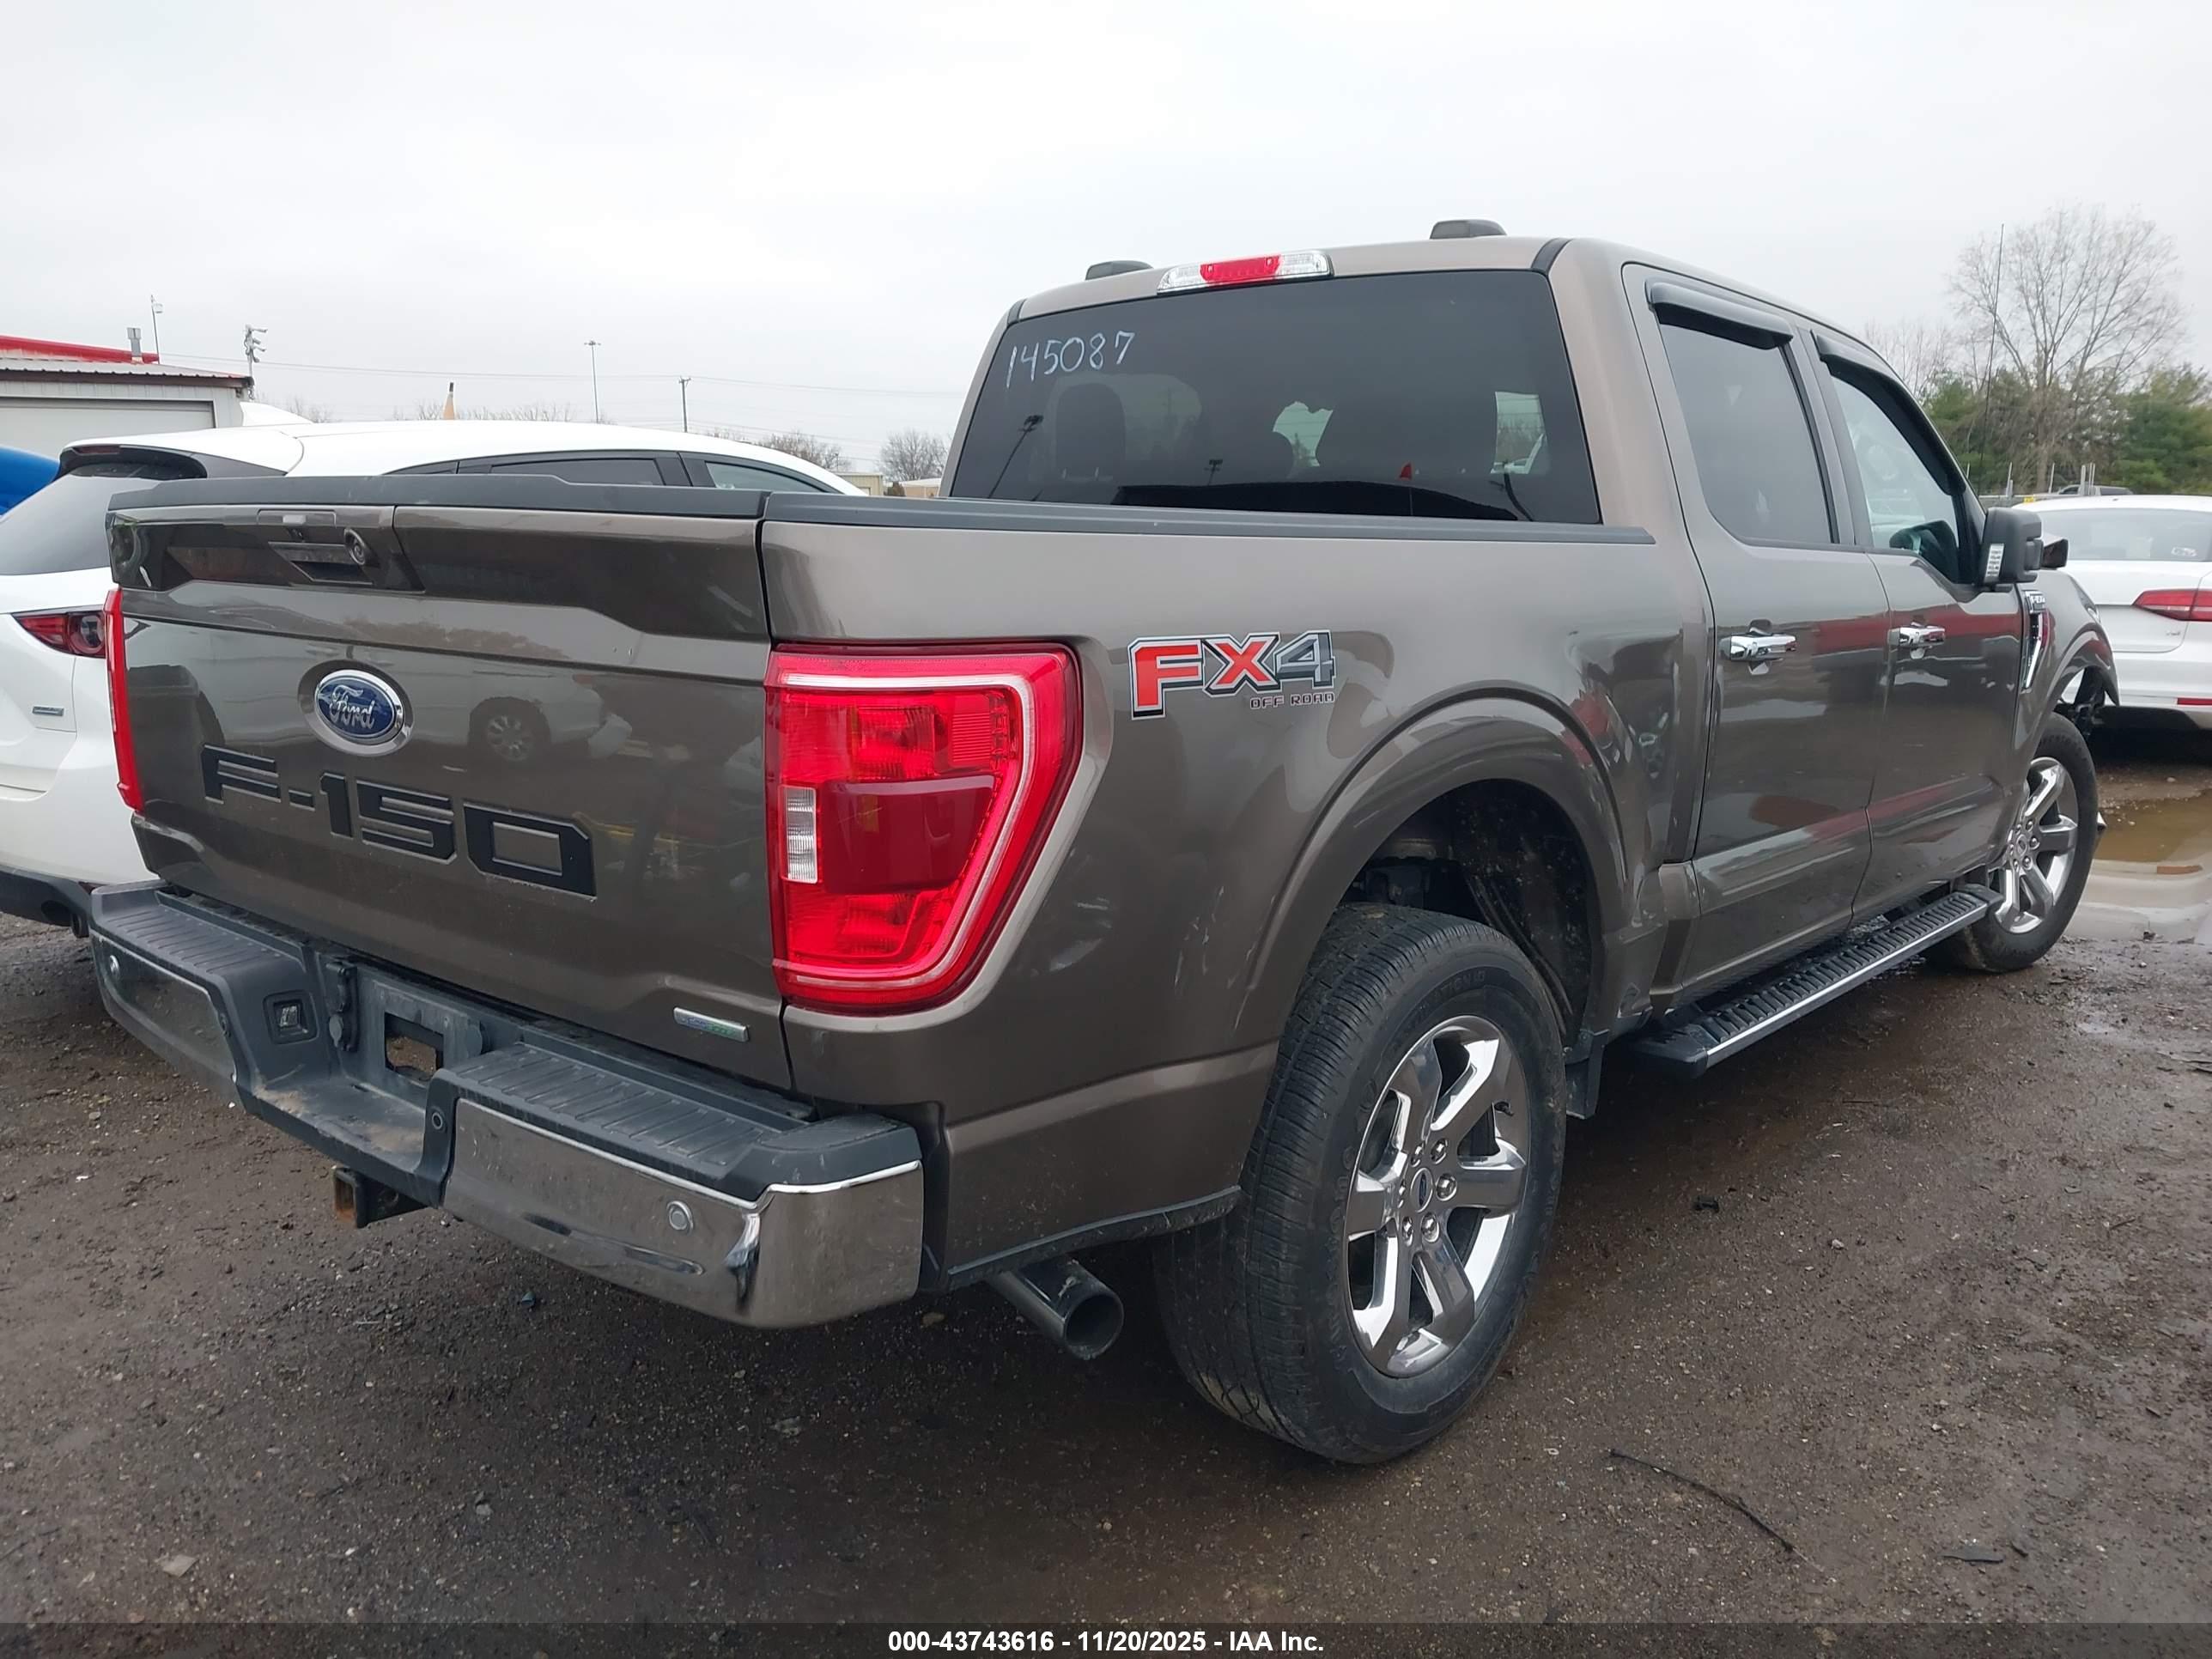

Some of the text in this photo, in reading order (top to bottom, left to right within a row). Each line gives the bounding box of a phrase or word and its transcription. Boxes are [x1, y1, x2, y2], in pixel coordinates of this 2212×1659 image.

[1006, 331, 1135, 388] 145087
[1127, 629, 1336, 720] FX4
[1250, 692, 1334, 708] OFF ROAD
[329, 684, 375, 729] Ford
[201, 744, 597, 902] F-150
